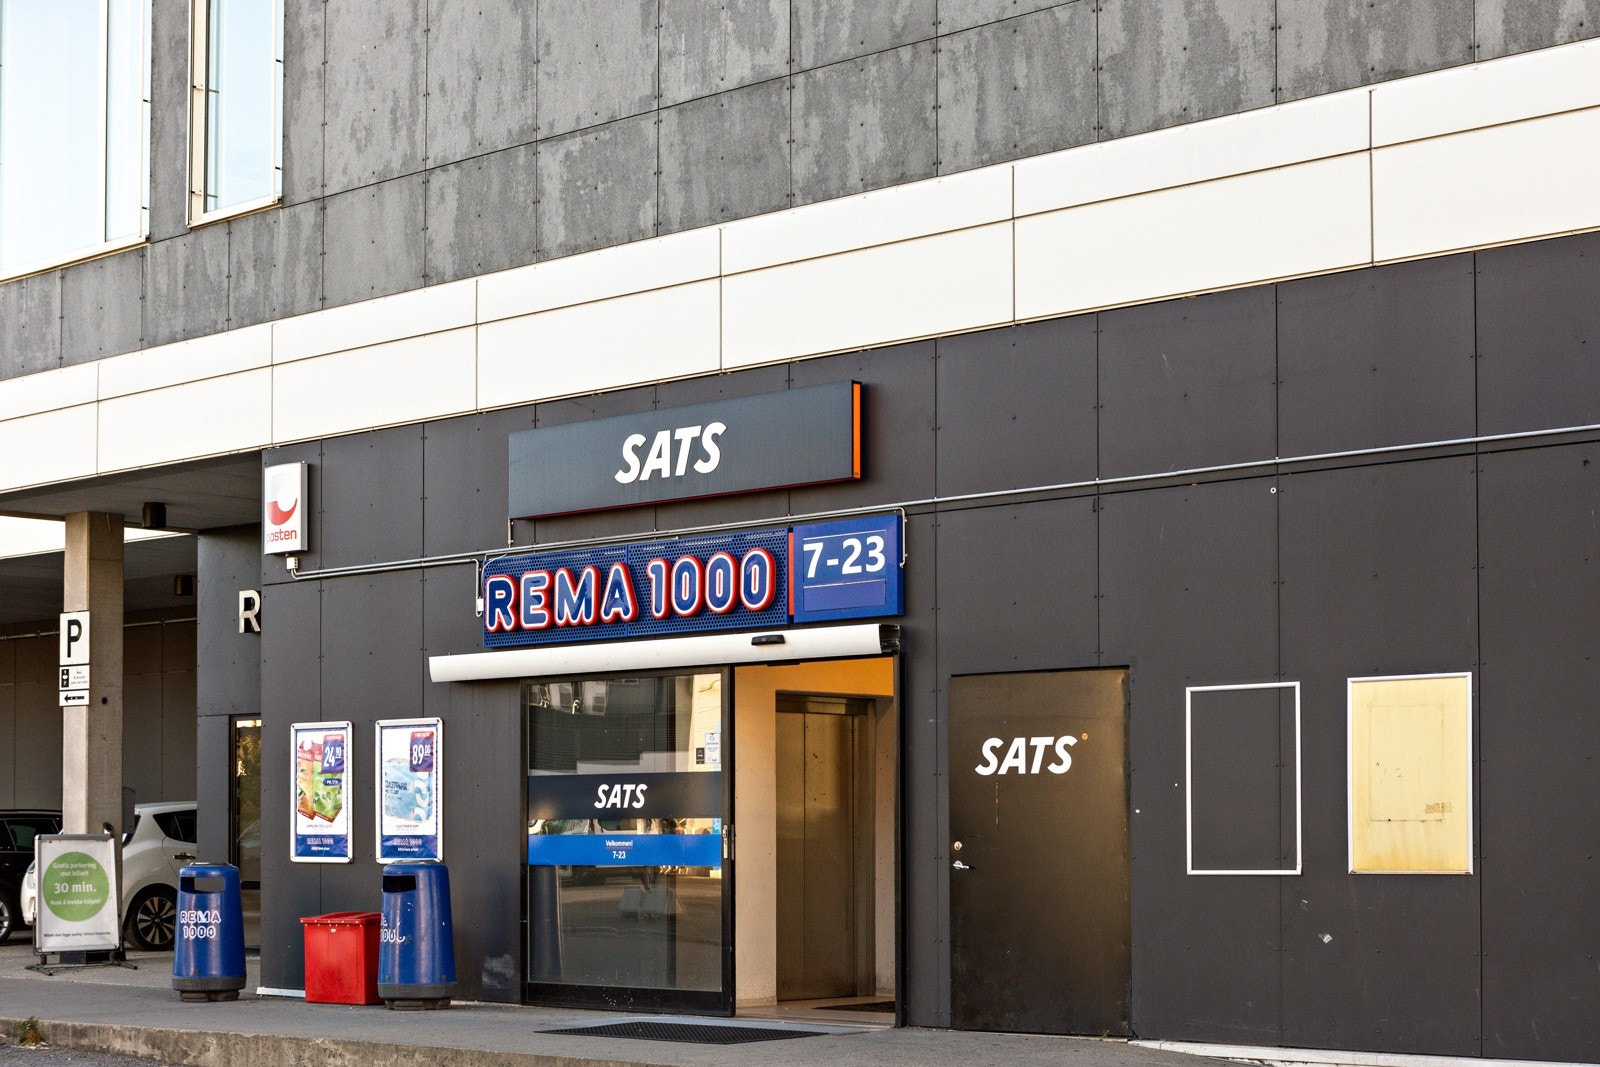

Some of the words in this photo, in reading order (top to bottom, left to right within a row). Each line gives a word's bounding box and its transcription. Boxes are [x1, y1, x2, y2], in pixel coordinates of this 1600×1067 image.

[614, 421, 727, 484] SATS
[803, 535, 886, 578] 7-23
[485, 561, 640, 633] REMA
[647, 547, 776, 620] 1000
[67, 619, 82, 657] P
[412, 744, 425, 765] 89
[974, 735, 1078, 776] SATS
[593, 783, 648, 809] SATS
[605, 839, 634, 847] Velkommen!
[612, 850, 626, 859] 7-23
[53, 882, 69, 894] 30
[72, 881, 97, 893] min.
[180, 910, 221, 924] REMA
[182, 925, 217, 939] 1000
